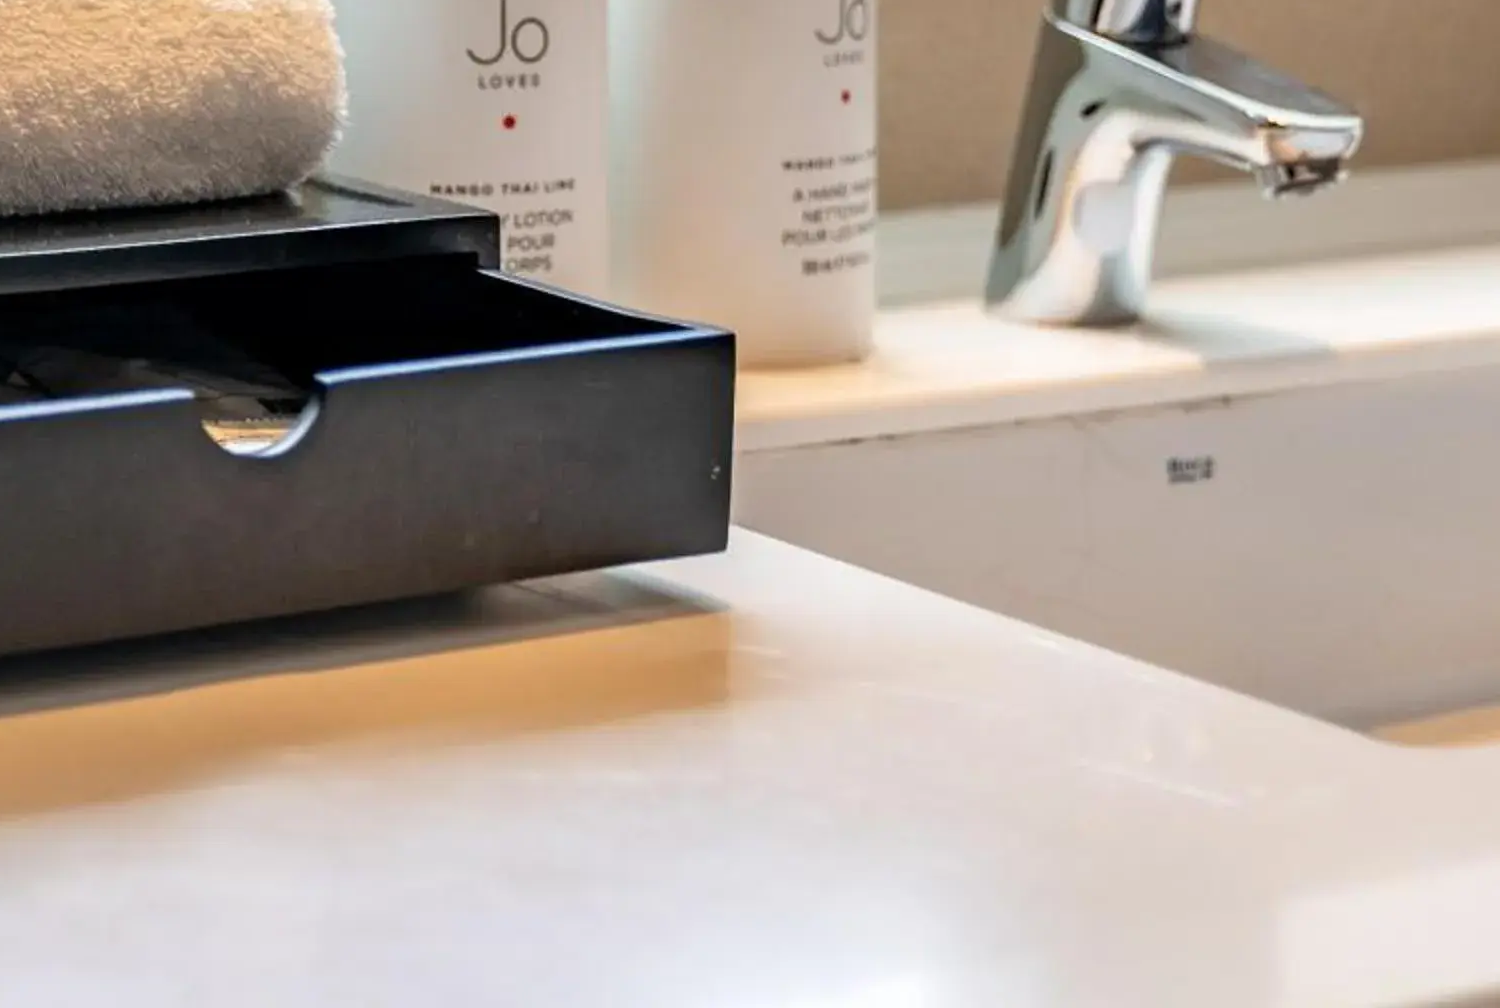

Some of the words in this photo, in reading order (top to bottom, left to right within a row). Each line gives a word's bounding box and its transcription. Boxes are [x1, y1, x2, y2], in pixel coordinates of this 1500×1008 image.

[477, 73, 541, 91] LOVES
[430, 183, 494, 196] MANGO
[514, 208, 574, 229] LOTION
